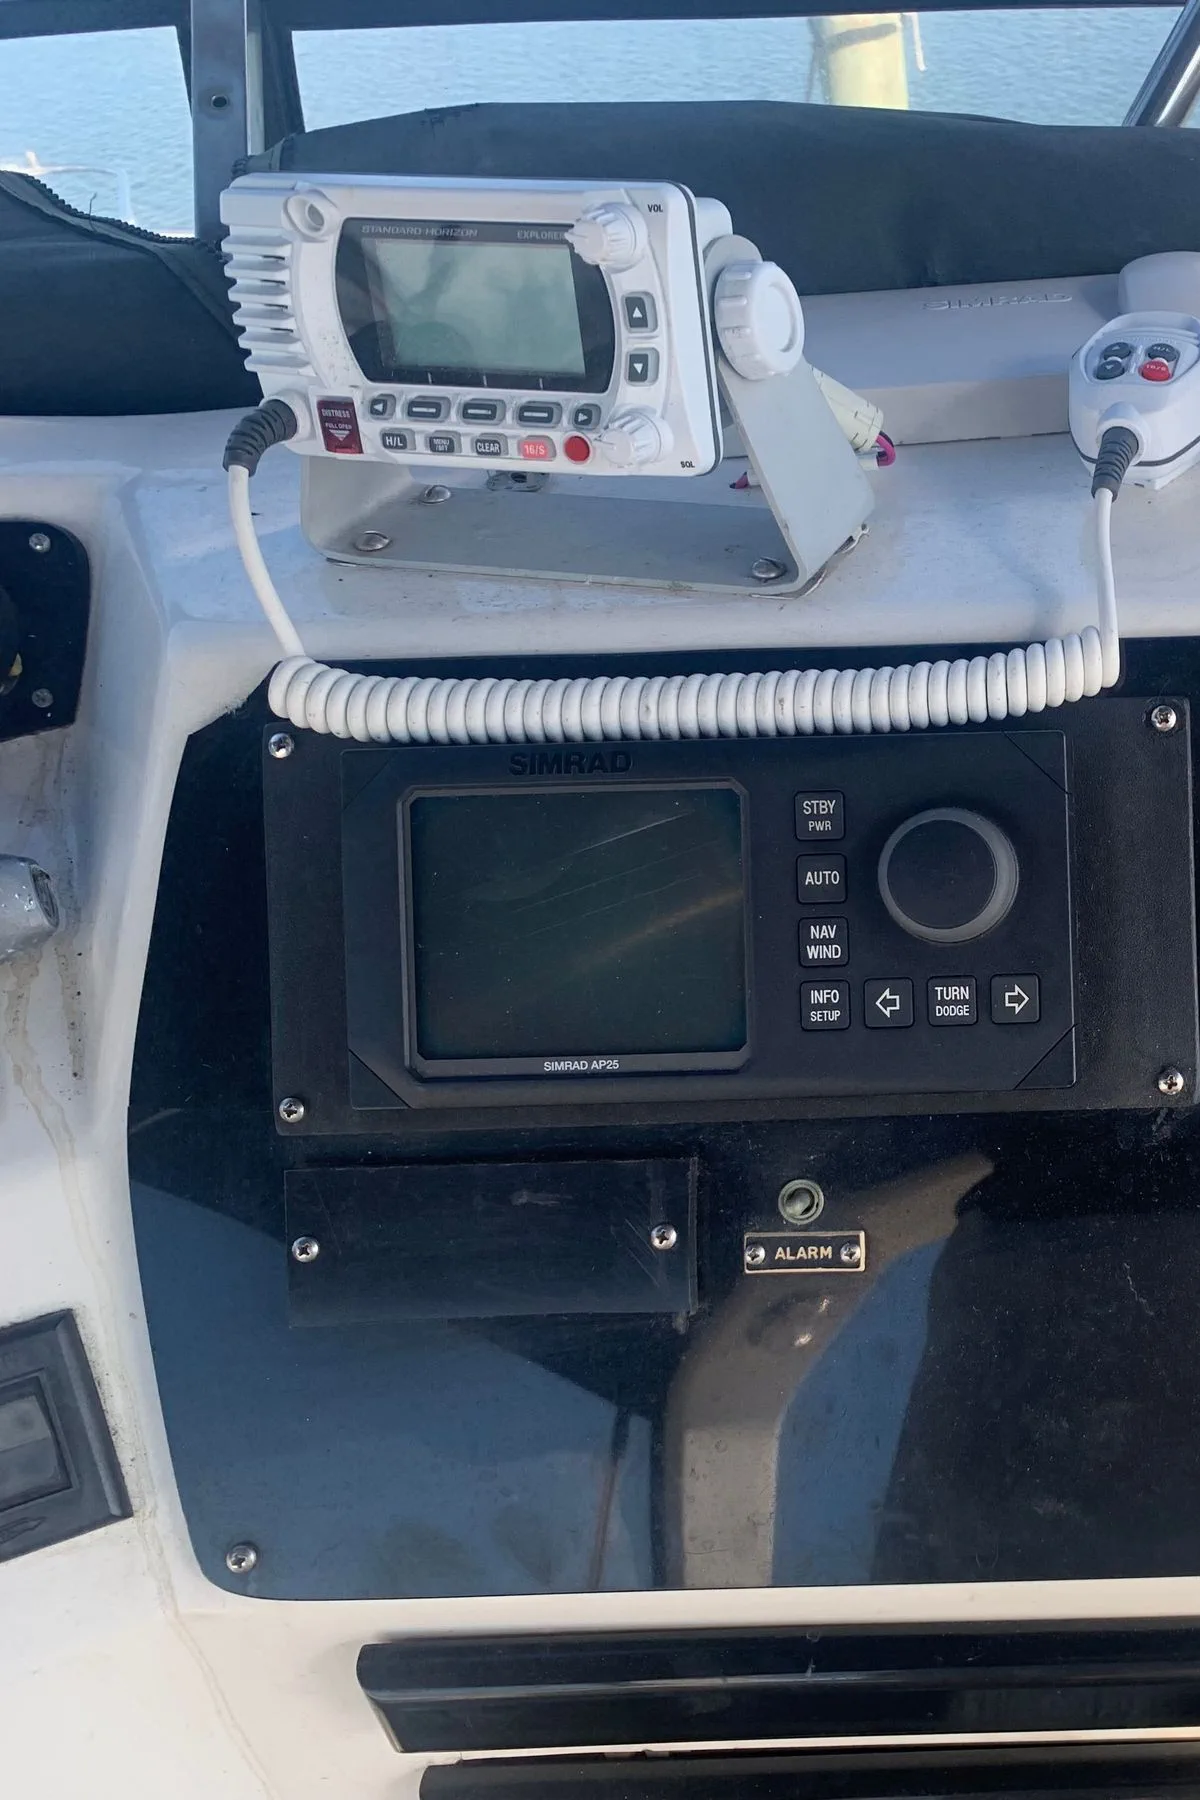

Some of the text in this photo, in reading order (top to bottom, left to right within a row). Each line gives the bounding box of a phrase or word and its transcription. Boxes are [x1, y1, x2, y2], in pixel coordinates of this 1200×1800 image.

[647, 204, 663, 213] VOL
[361, 224, 478, 238] STANDARD HORIZON
[385, 436, 404, 447] H/L
[477, 442, 500, 453] CLEAR
[680, 461, 696, 469] SQL
[509, 752, 633, 776] SIMRAD
[803, 800, 836, 815] STBY
[808, 821, 832, 832] PWR
[805, 871, 840, 886] AUTO
[810, 925, 837, 939] NAV
[806, 945, 841, 959] WIND
[810, 989, 840, 1004] INFO
[935, 986, 970, 1001] TURN
[810, 1011, 841, 1022] SETUP
[935, 1005, 970, 1017] DODGE
[543, 1059, 620, 1072] SIMRAD AP25
[774, 1245, 833, 1261] ALARM
